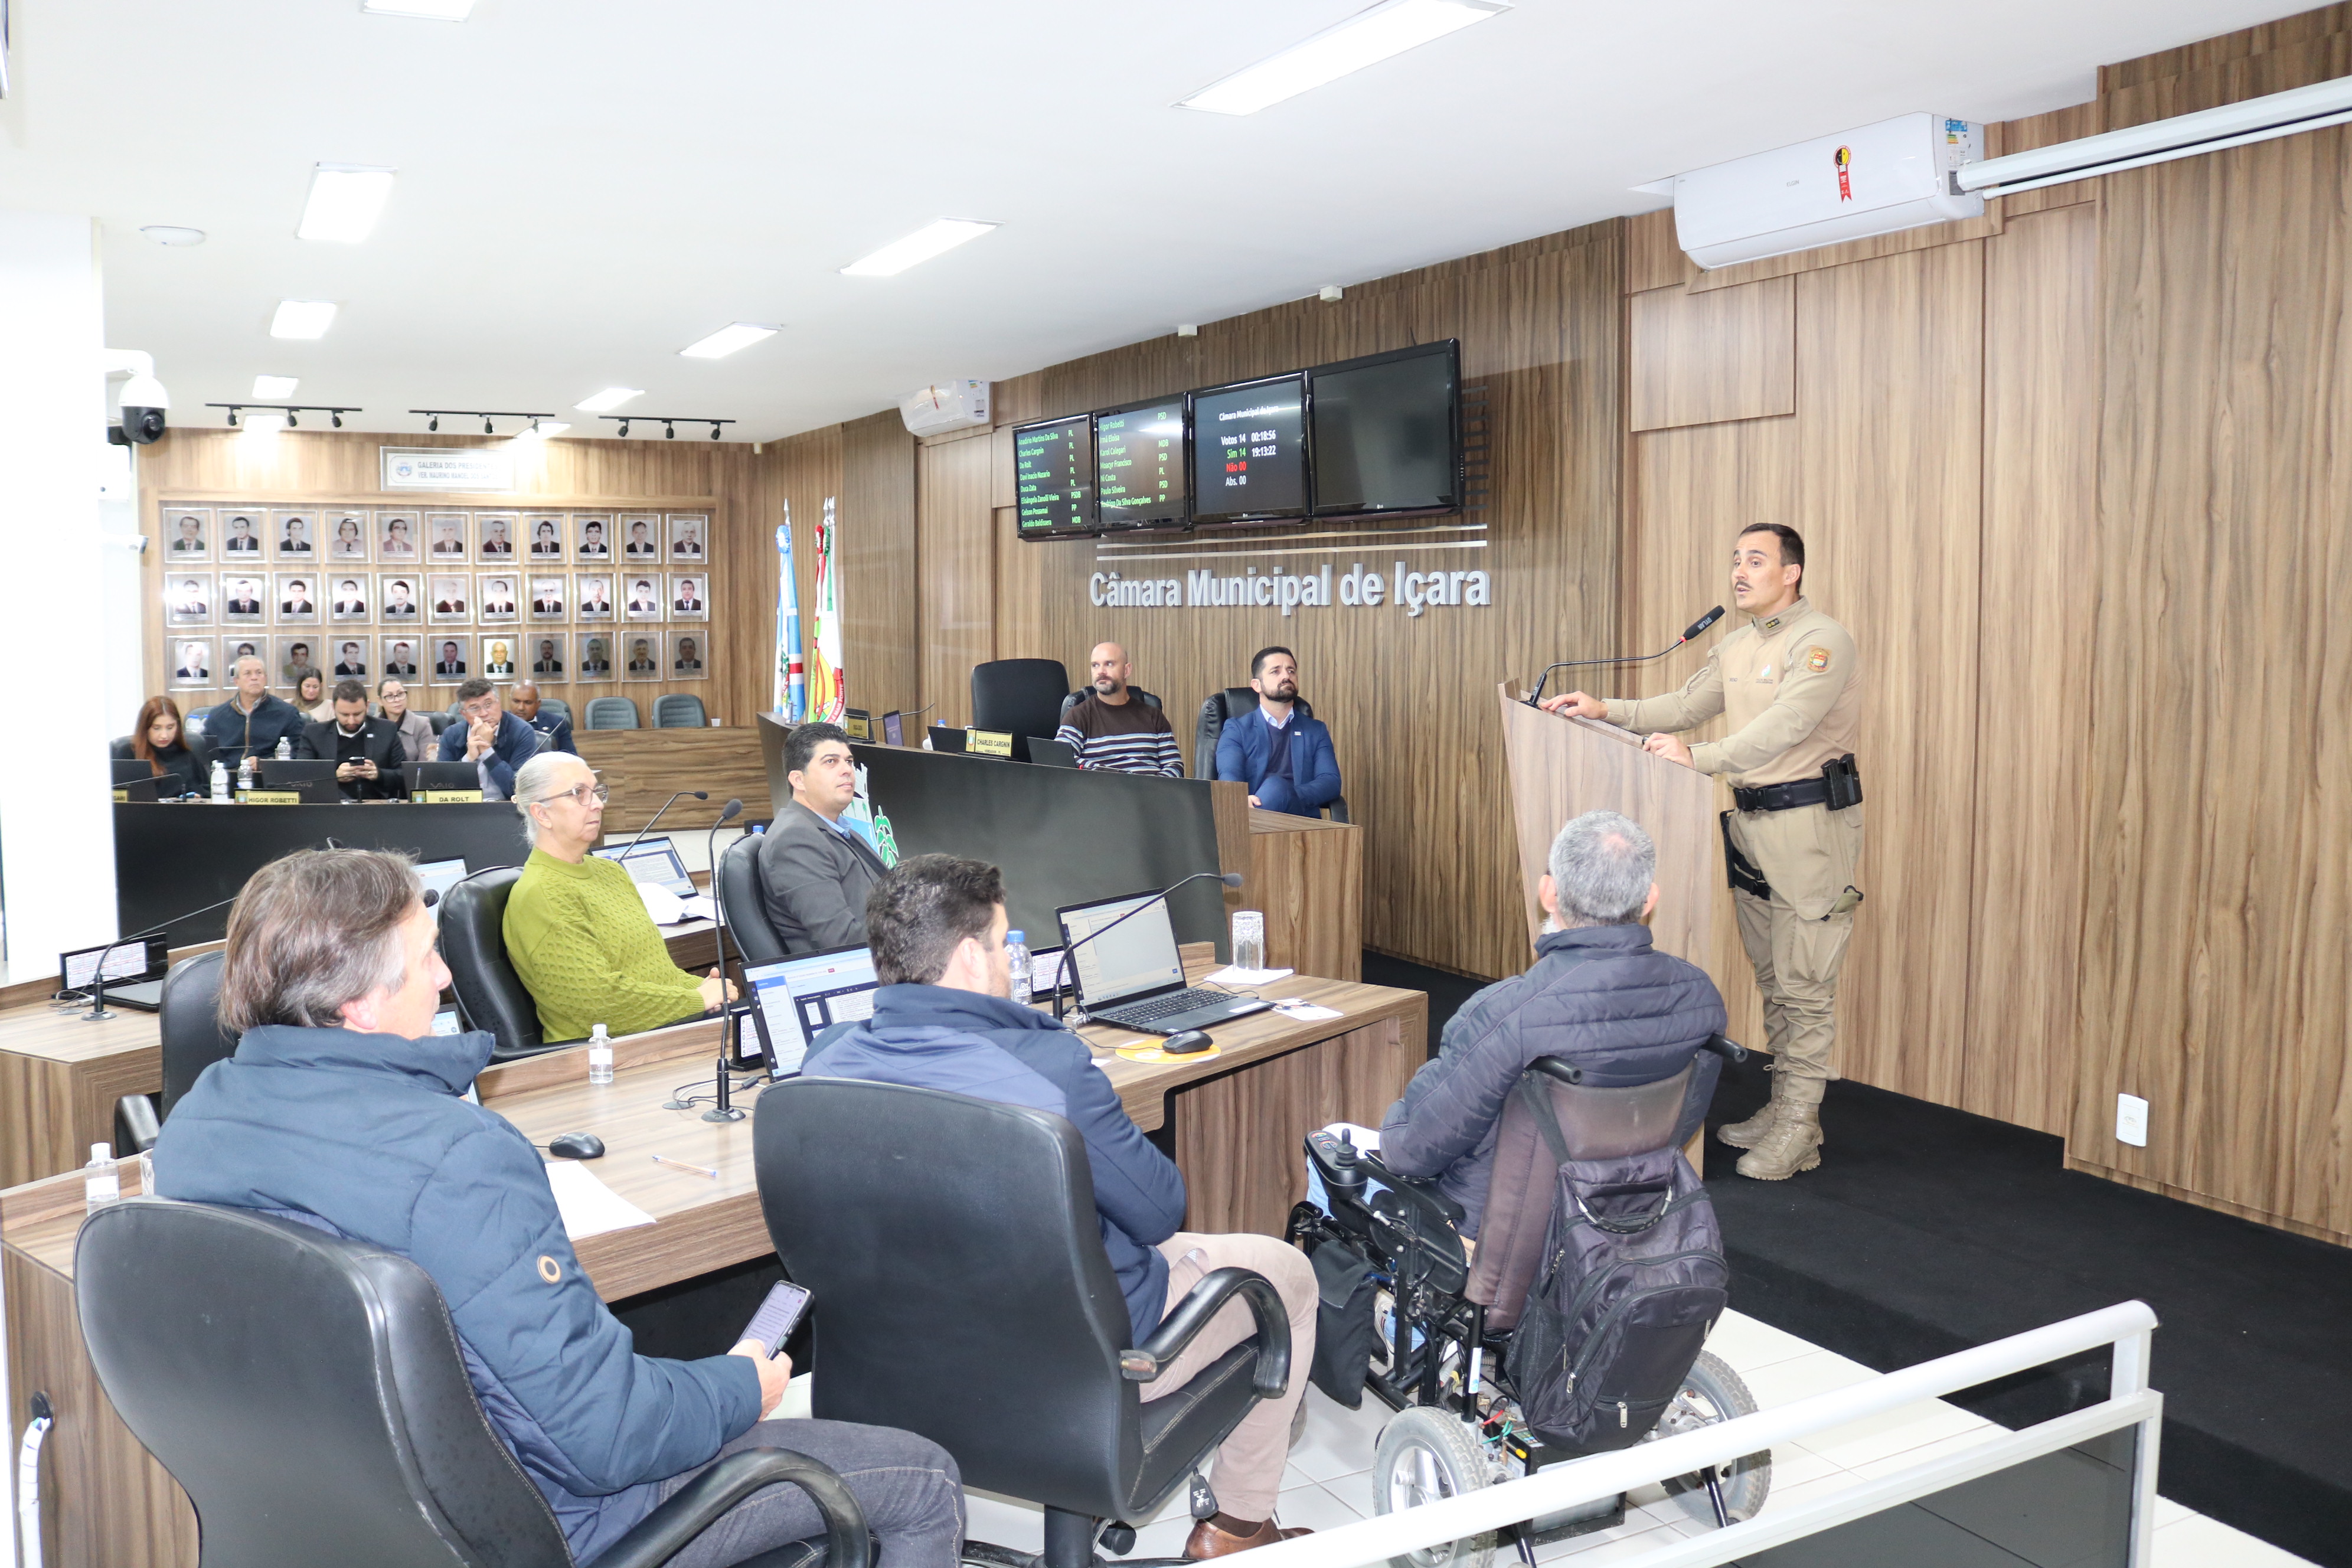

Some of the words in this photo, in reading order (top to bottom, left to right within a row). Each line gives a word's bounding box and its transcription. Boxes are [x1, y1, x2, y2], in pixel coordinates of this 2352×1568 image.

[1158, 412, 1167, 420] PSD
[1219, 412, 1236, 421] Câmara
[1237, 407, 1259, 418] Municipal
[1099, 423, 1110, 432] Higor
[1110, 419, 1125, 429] Robetti
[1099, 435, 1108, 443] Irmã
[1108, 434, 1120, 442] Eloisa
[1221, 436, 1237, 446] Votos
[1239, 433, 1246, 443] 14
[1251, 430, 1276, 443] 00:18:56
[1158, 439, 1169, 447] MDB
[1019, 449, 1031, 457] Charles
[1100, 447, 1110, 456] Karol
[1110, 445, 1126, 456] Calegari
[1227, 448, 1237, 459] Sim
[1239, 447, 1246, 458] 14
[1252, 445, 1276, 458] 19:13:22
[1158, 453, 1167, 461] PSD
[1100, 462, 1114, 470] Moacyr
[1114, 459, 1132, 468] Francisco
[1226, 462, 1238, 472] Não
[1239, 461, 1247, 471] 00
[1037, 470, 1050, 478] Nazario
[1159, 480, 1168, 489] PSD
[1226, 476, 1238, 486] Abs.
[1239, 475, 1246, 485] 00
[1071, 491, 1081, 499] PSDB
[1100, 486, 1112, 495] Paulo
[1112, 485, 1126, 494] Silveira
[1122, 498, 1131, 506] Silva
[1131, 496, 1151, 507] Gonçalves
[1159, 494, 1165, 502] PP
[1033, 507, 1048, 515] Possamai
[1022, 520, 1034, 528] Geraldo
[1090, 571, 1182, 607] Câmara
[1188, 564, 1332, 616] Municipal
[1340, 563, 1385, 606] de
[1394, 561, 1491, 616] Içara
[1697, 617, 1712, 630] DYLAN
